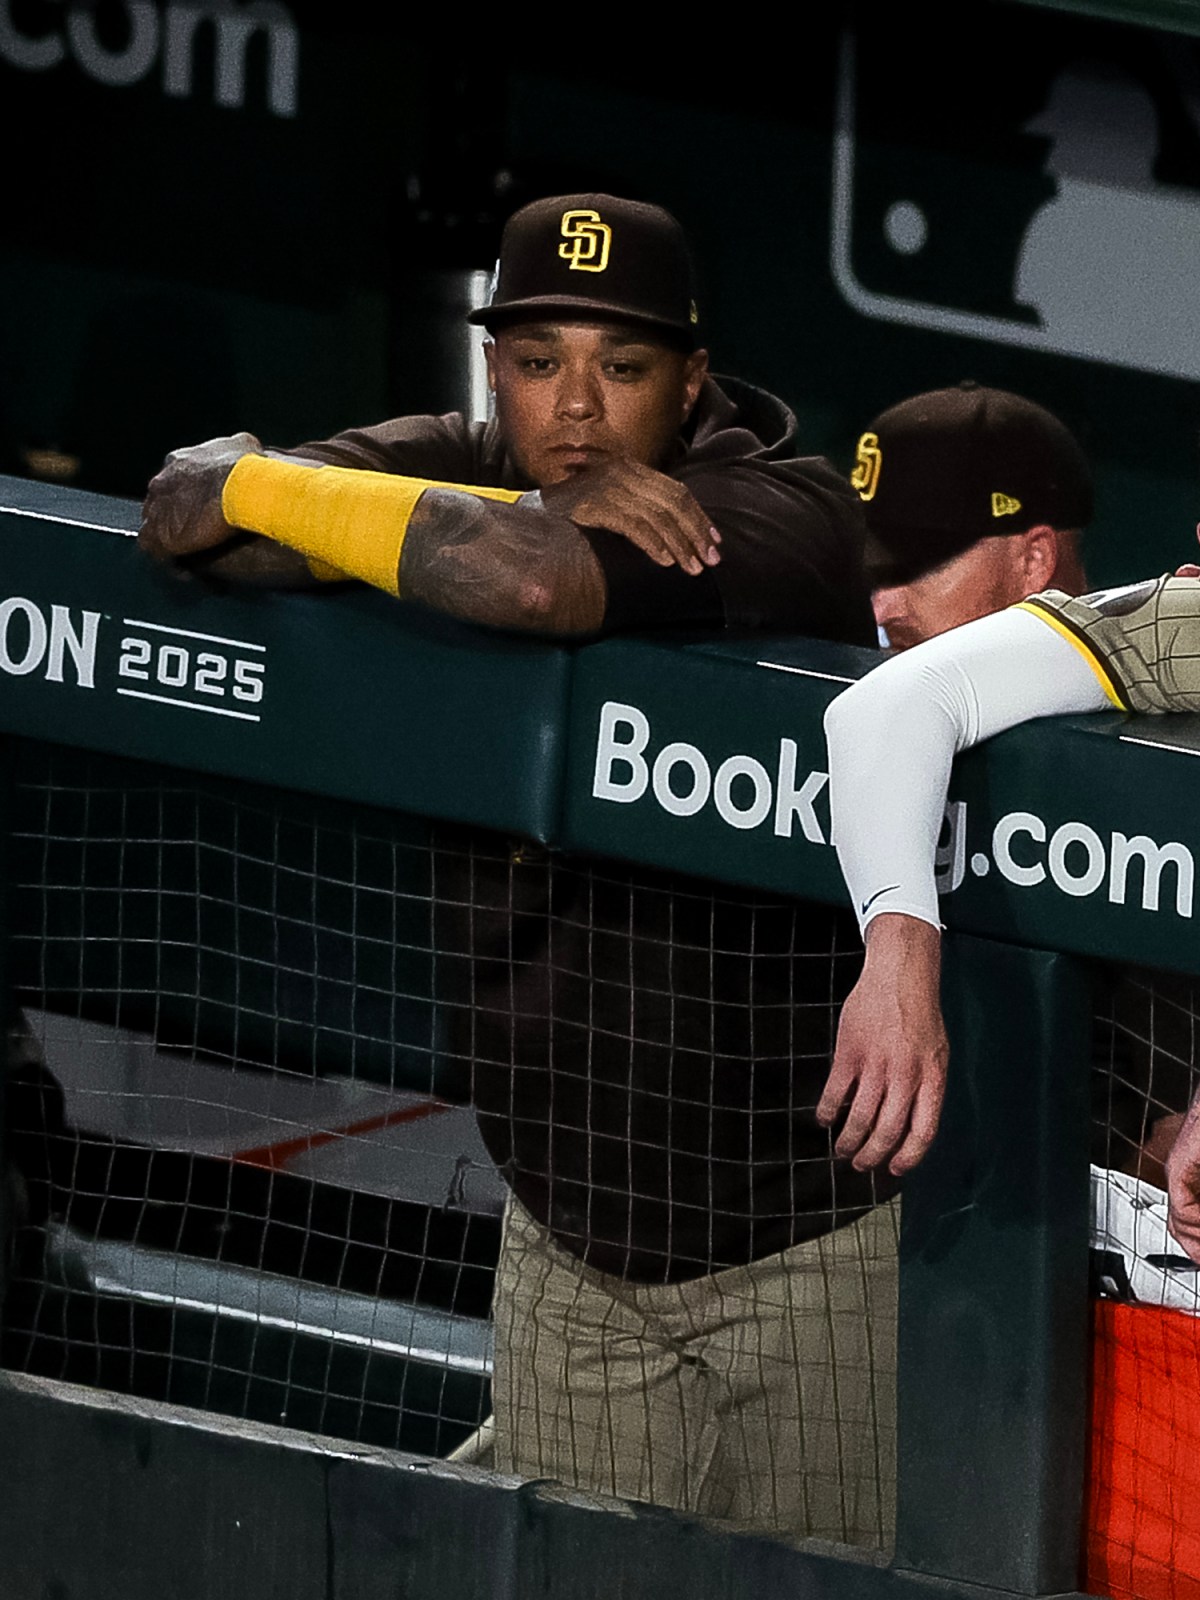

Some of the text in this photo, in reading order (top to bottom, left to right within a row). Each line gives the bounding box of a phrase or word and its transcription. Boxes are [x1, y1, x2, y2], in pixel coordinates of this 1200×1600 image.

[558, 209, 612, 273] SD
[0, 597, 266, 703] ON 2025
[592, 701, 1195, 918] Book.com
